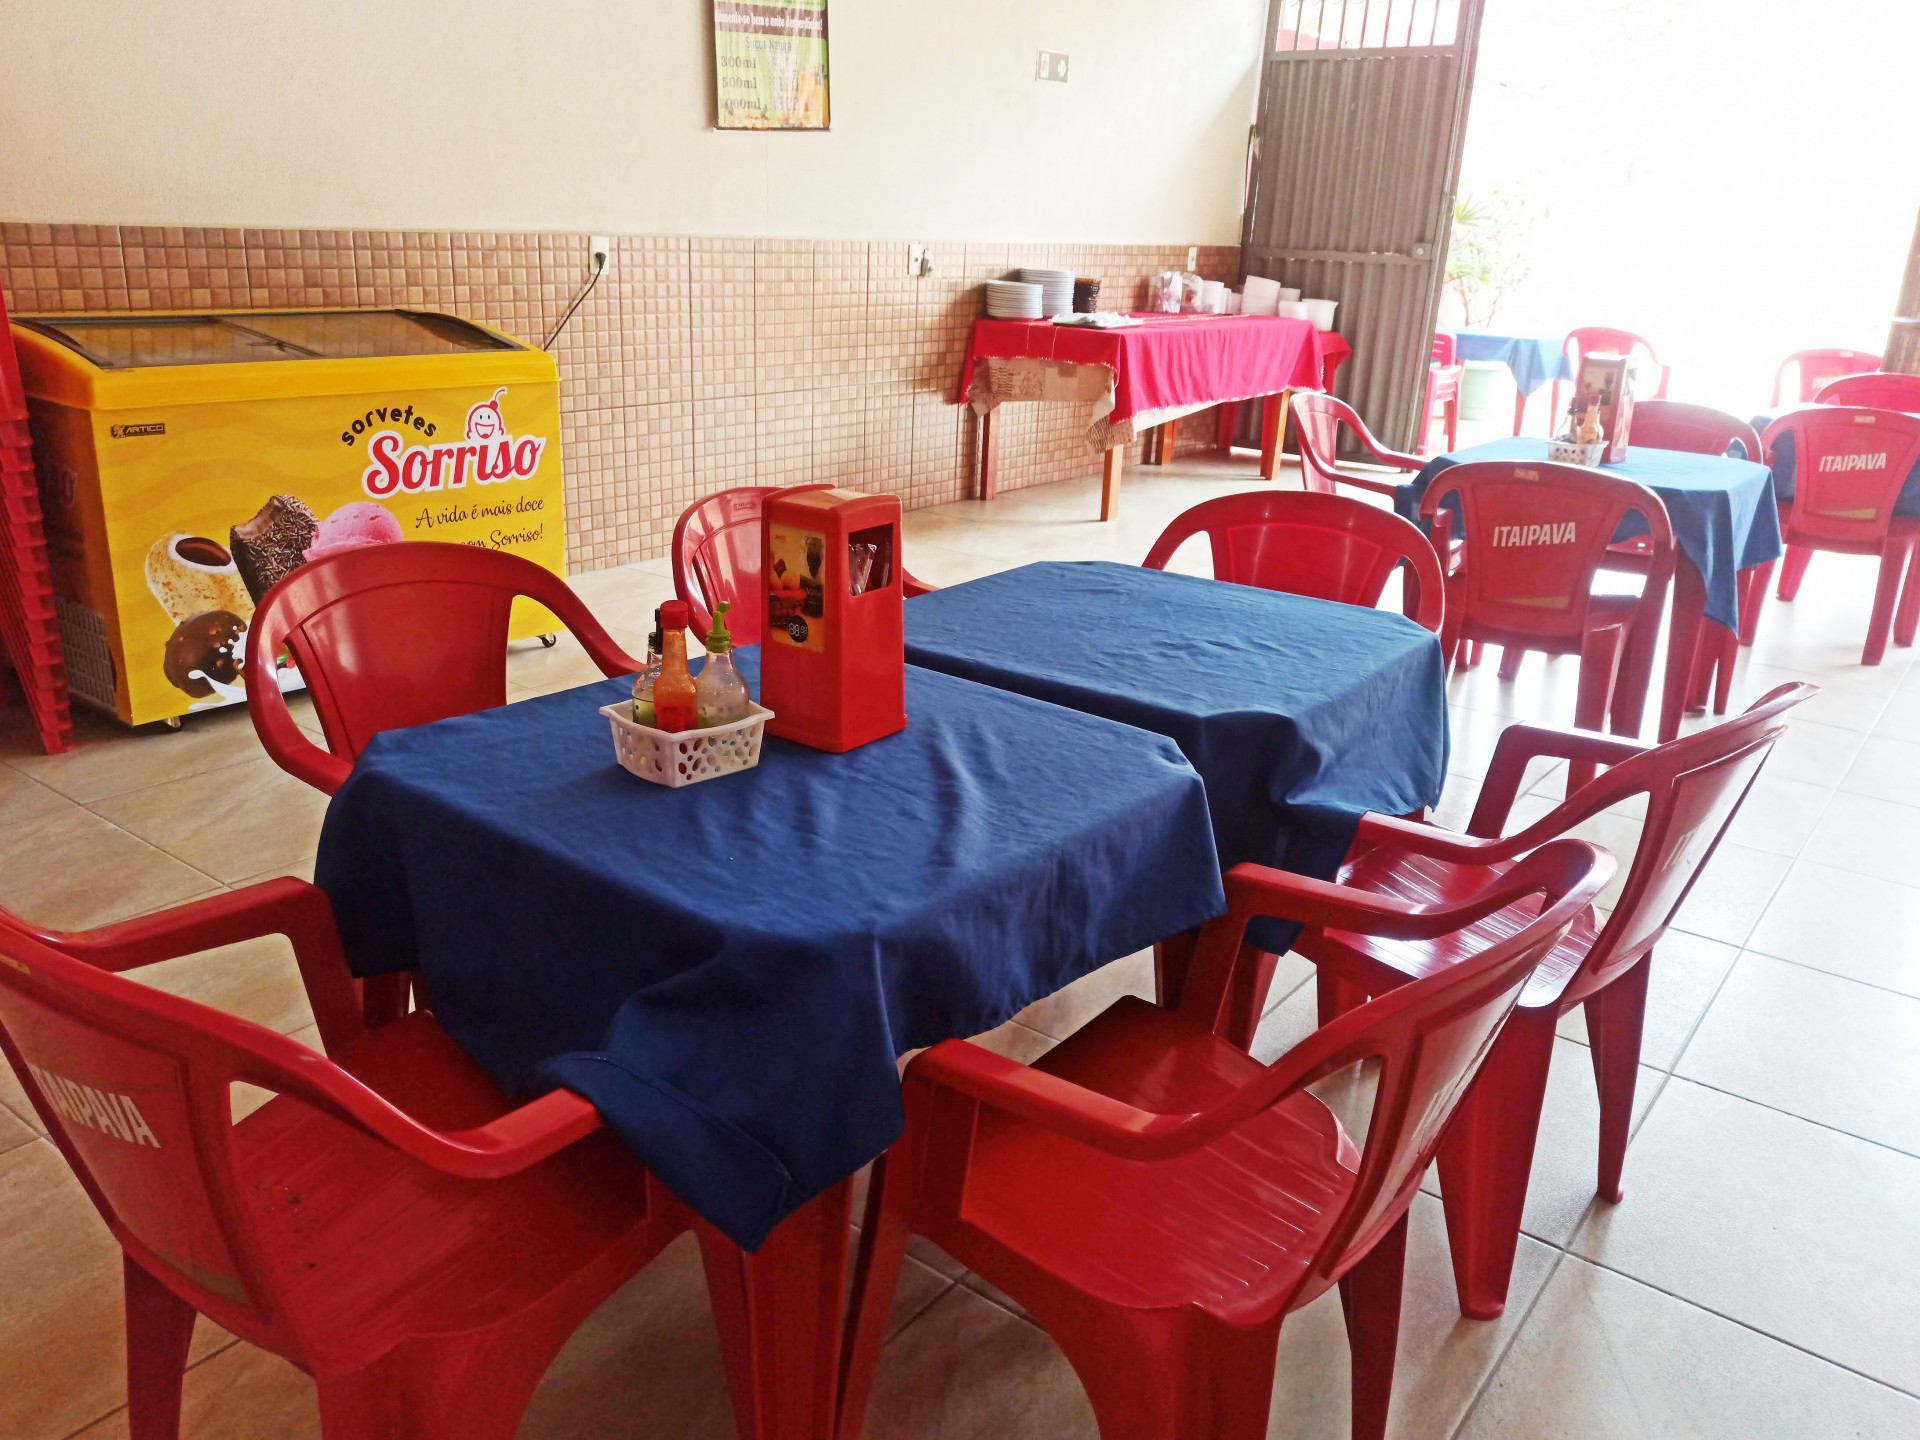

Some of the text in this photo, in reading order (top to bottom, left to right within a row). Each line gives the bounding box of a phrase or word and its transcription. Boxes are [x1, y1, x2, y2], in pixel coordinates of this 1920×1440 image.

[126, 424, 164, 433] ARTICO
[342, 405, 437, 446] sorvetes
[367, 435, 541, 494] Sorriso
[1819, 452, 1887, 473] ITAIPAVA
[415, 495, 545, 528] A vida é mais doce
[490, 522, 544, 550] Sorriso!
[1492, 522, 1576, 547] ITAIPAVA
